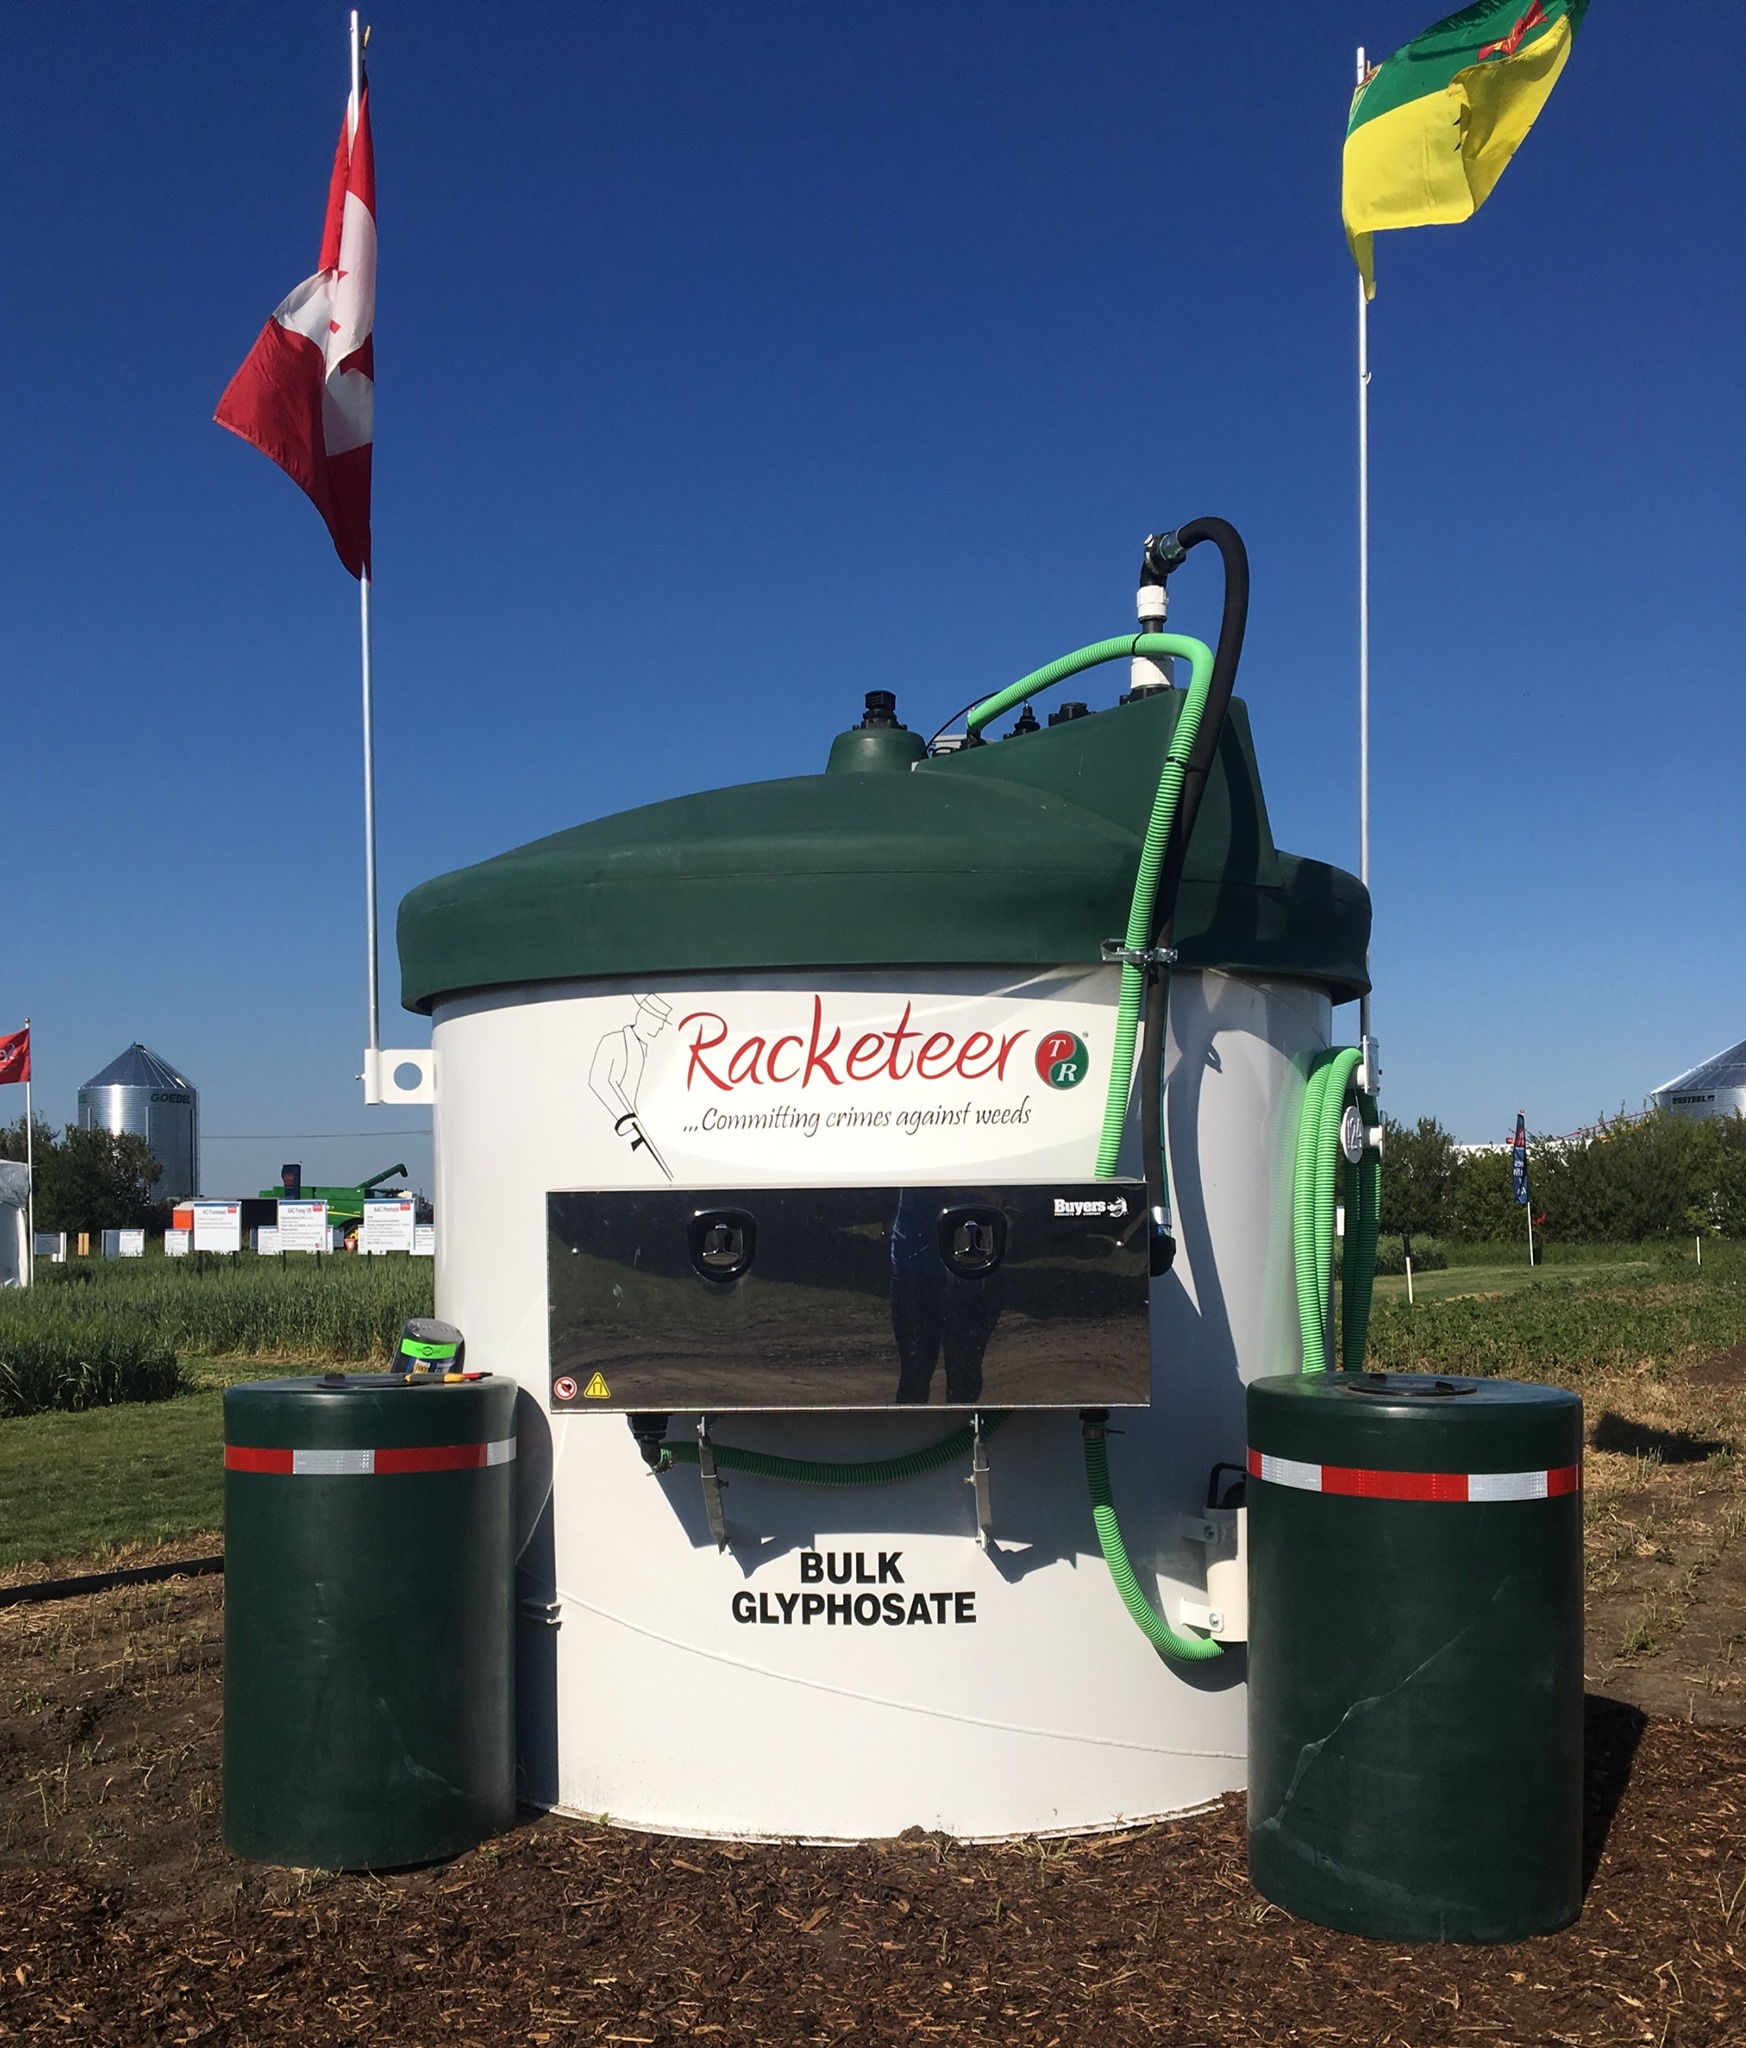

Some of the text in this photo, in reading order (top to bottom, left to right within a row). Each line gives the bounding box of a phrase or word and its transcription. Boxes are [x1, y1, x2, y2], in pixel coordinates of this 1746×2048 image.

[678, 994, 1031, 1092] Racketeer
[1048, 1039, 1067, 1058] T
[1056, 1063, 1078, 1082] R
[150, 1093, 191, 1104] GOEBEL
[825, 1105, 892, 1128] crimes
[895, 1101, 972, 1136] against
[974, 1095, 1032, 1125] weeds
[1053, 1198, 1107, 1216] Buyers
[800, 1551, 905, 1584] BULK
[731, 1591, 977, 1626] GLYPHOSATE
